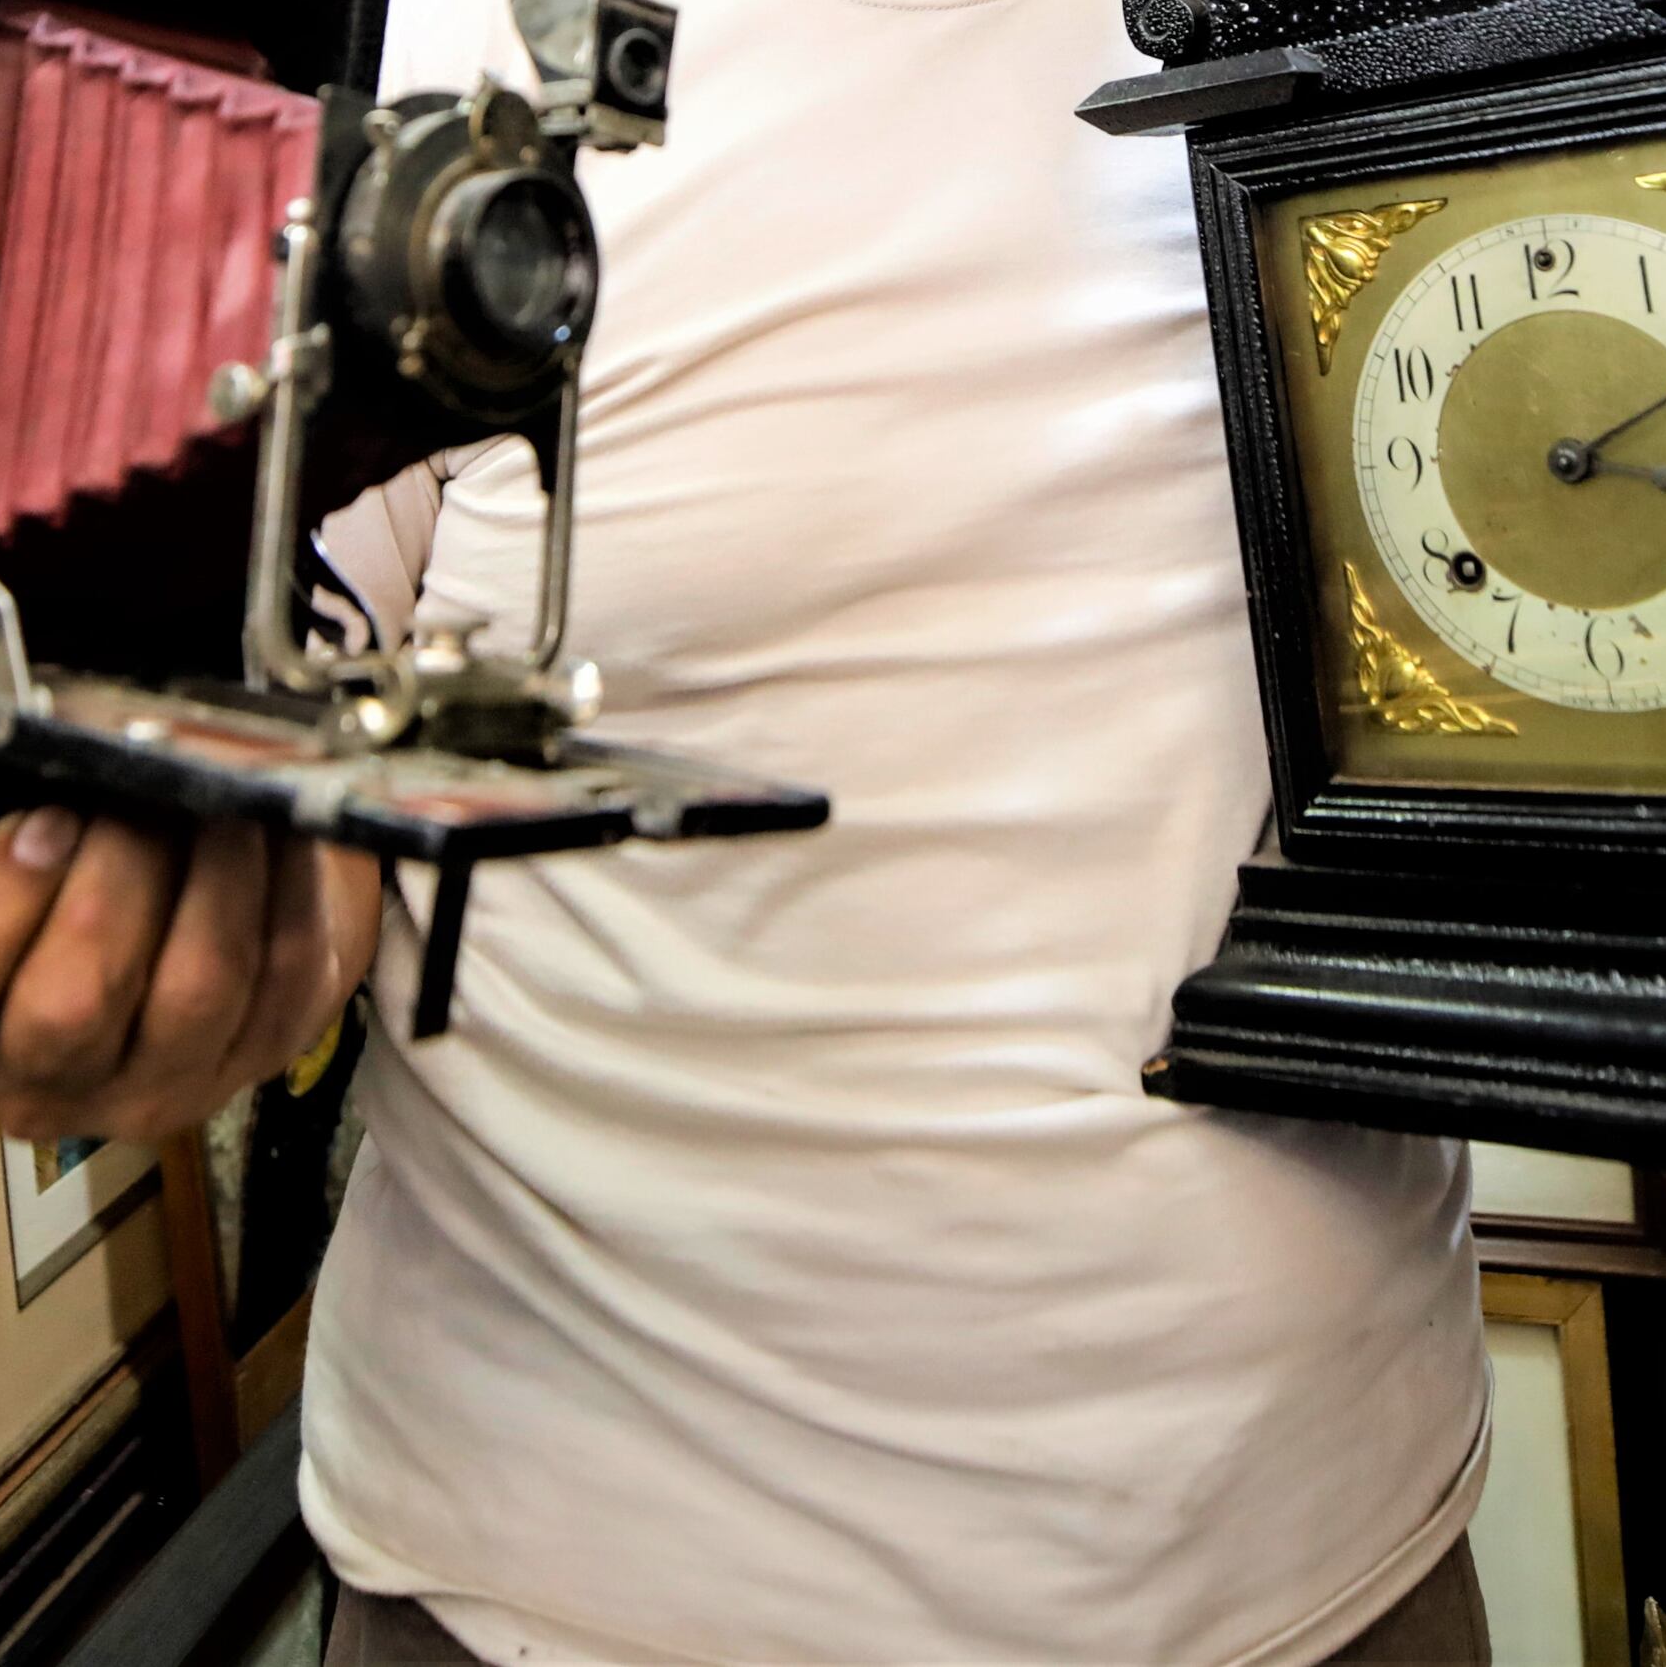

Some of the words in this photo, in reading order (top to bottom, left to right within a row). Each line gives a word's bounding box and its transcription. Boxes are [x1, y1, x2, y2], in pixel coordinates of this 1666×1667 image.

[1524, 238, 1580, 301] 12
[1638, 254, 1655, 314] 1
[1450, 273, 1485, 332] 11
[1393, 344, 1434, 404] 10
[1387, 435, 1423, 494] 9
[1420, 527, 1459, 590] 8
[1490, 589, 1523, 655] 7
[1584, 615, 1625, 678] 6
